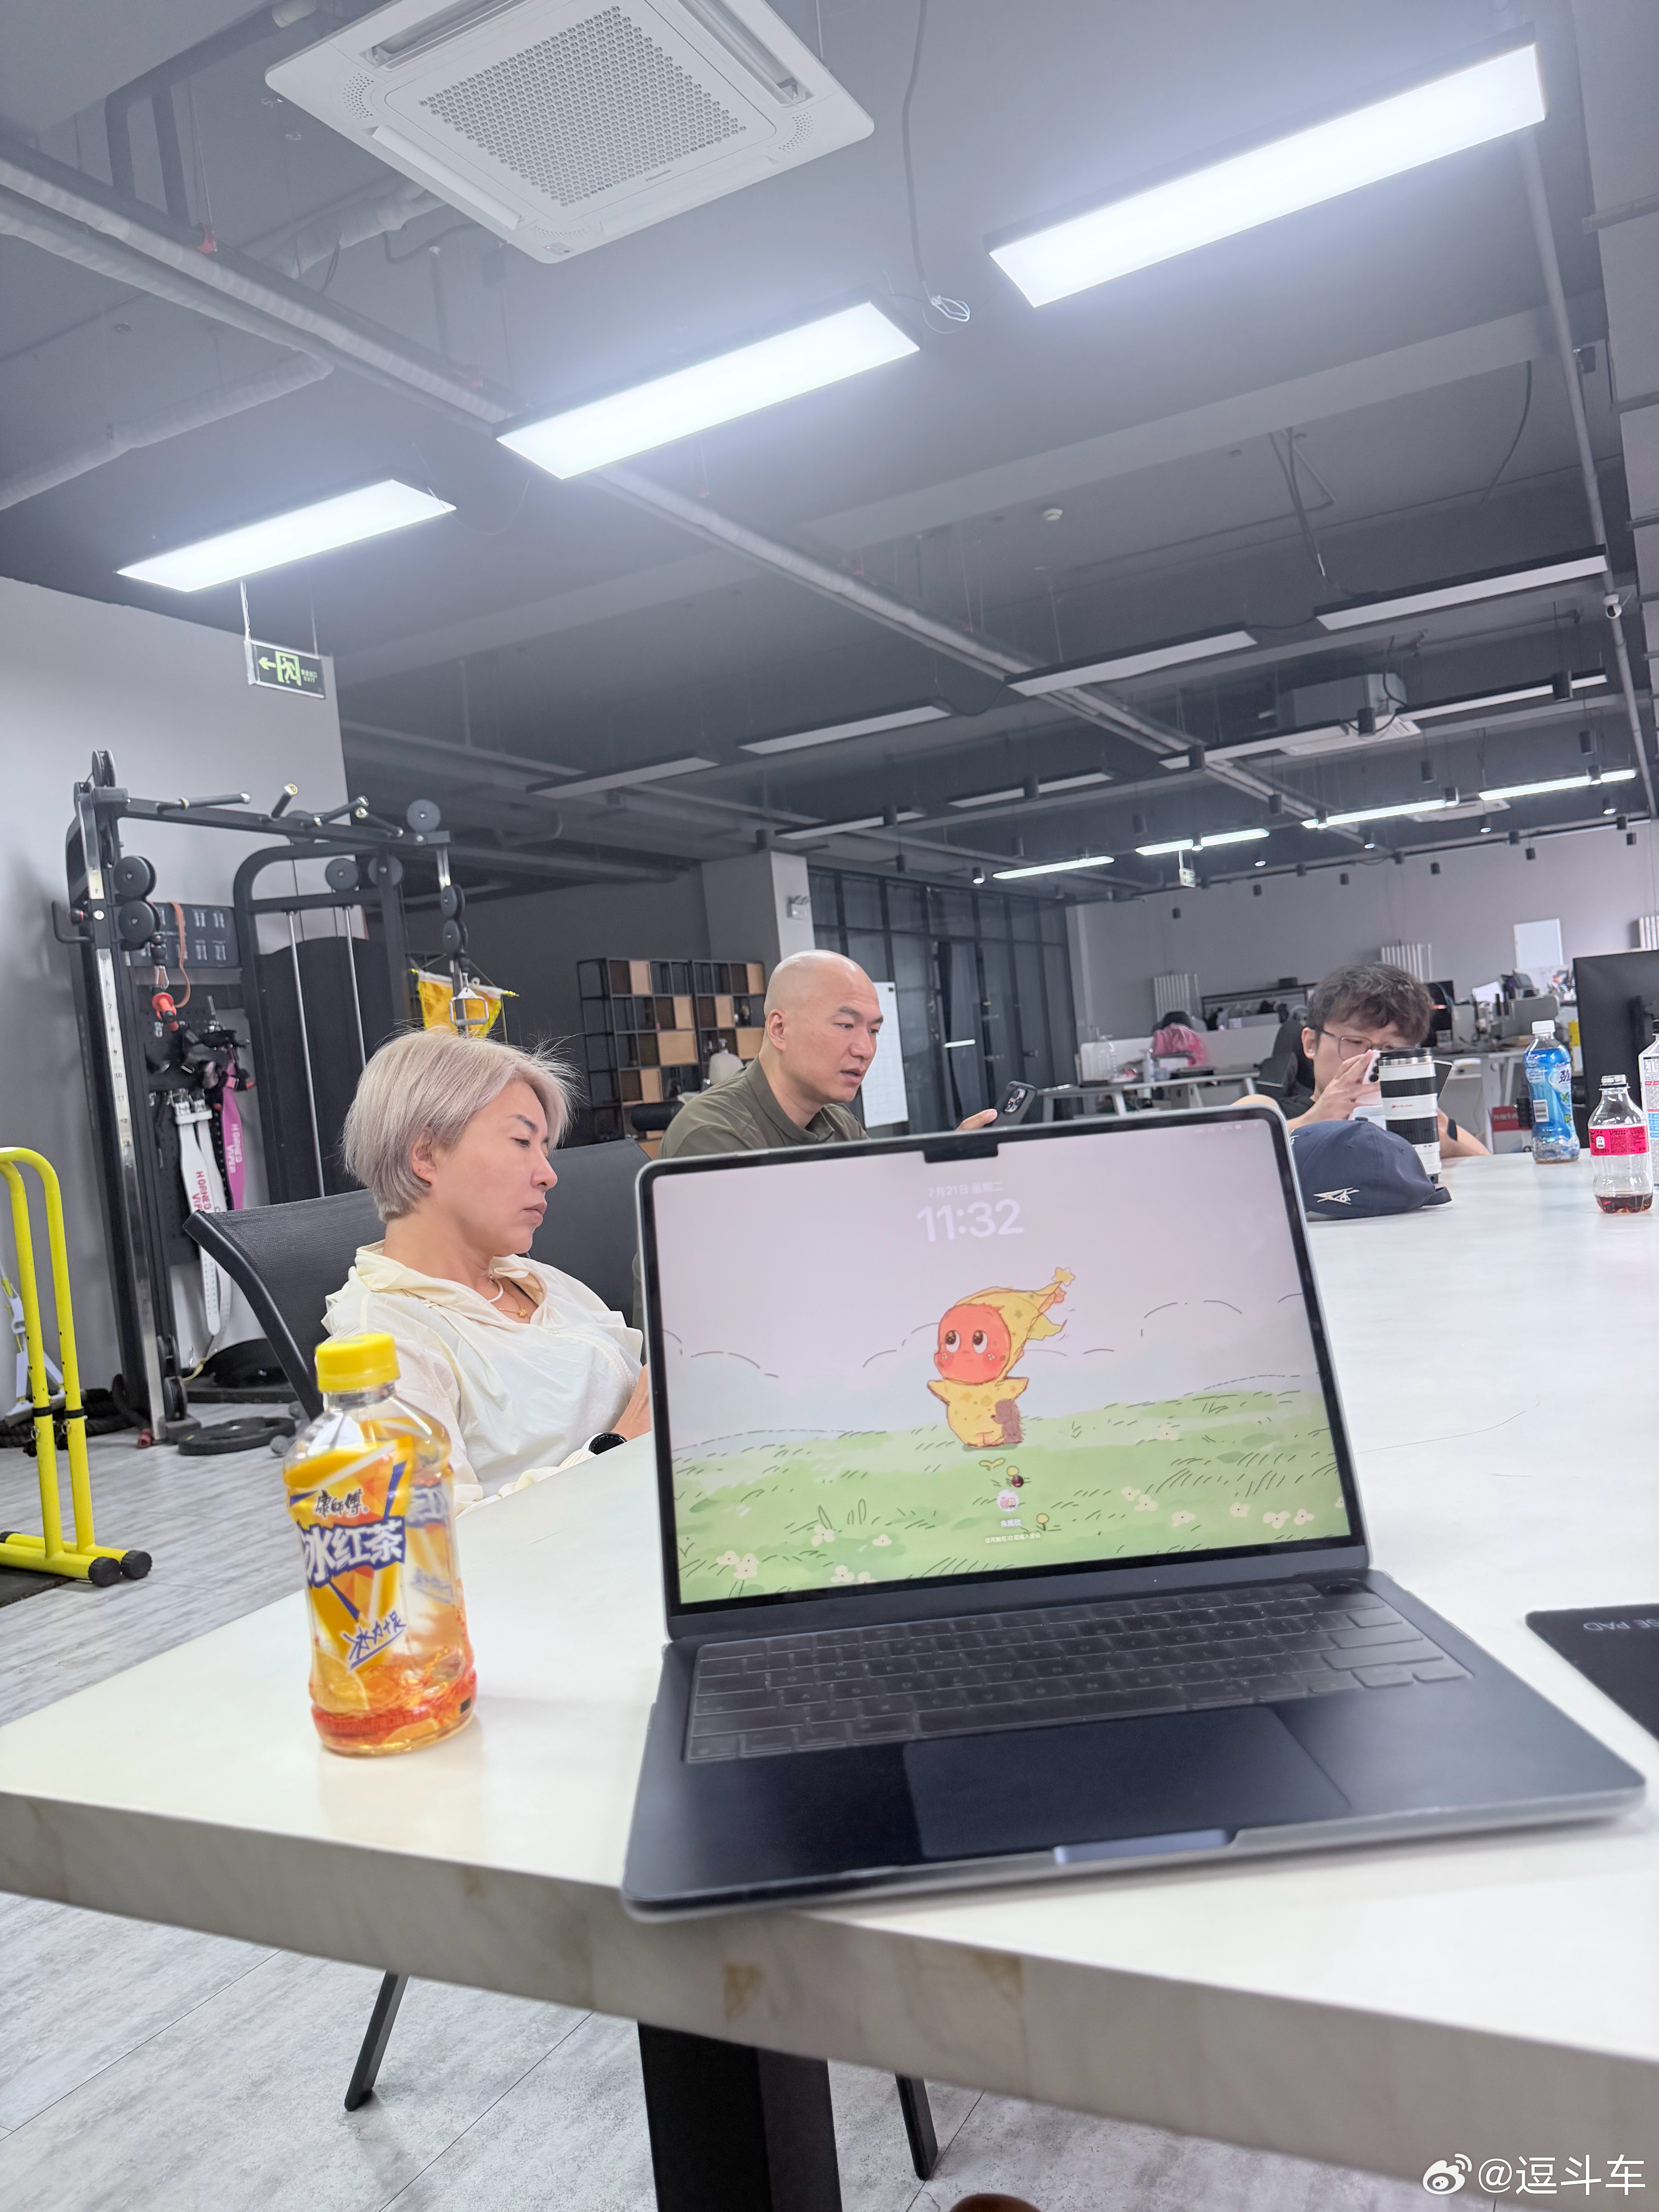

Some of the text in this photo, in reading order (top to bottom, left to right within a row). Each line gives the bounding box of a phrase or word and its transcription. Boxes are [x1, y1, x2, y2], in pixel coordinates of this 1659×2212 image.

[196, 1171, 212, 1210] HORNED
[927, 1183, 969, 1197] 7月21日
[916, 1199, 1025, 1242] 11:32
[302, 1519, 404, 1581] 冰红茶
[1583, 1620, 1631, 1631] PAD
